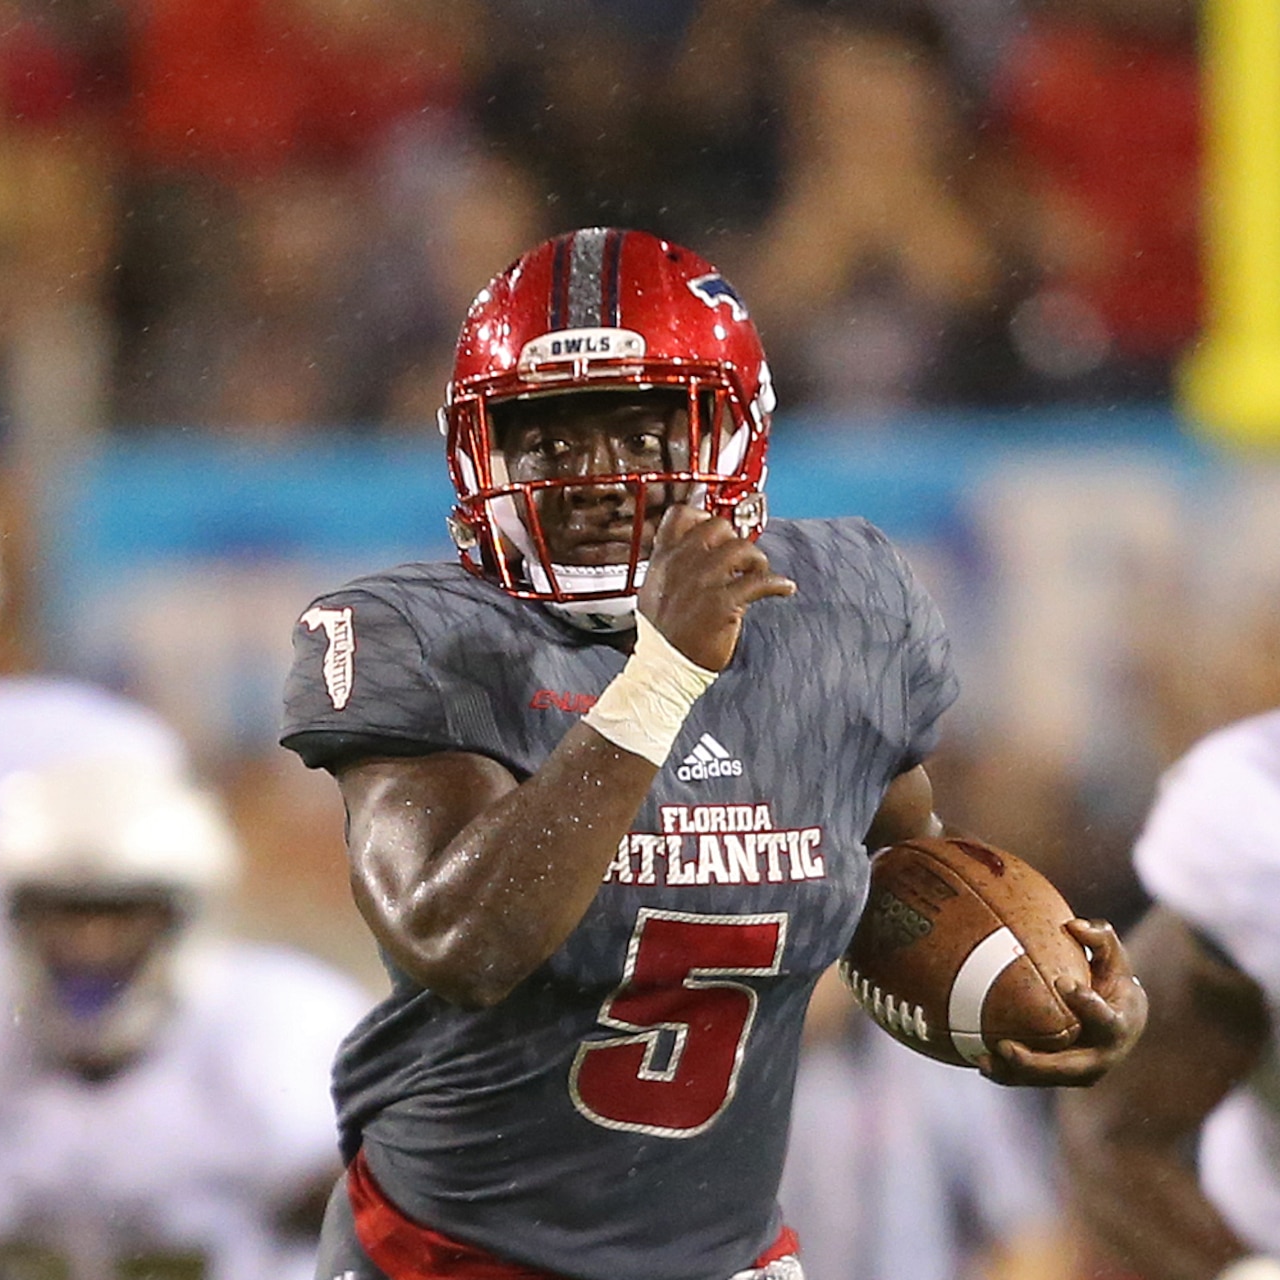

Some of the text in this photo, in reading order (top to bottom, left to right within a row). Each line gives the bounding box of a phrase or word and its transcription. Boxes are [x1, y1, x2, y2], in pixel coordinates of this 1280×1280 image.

[551, 336, 612, 356] OWLS
[332, 619, 350, 697] ATLANTIC
[676, 757, 744, 782] adidas
[659, 801, 773, 834] FLORIDA
[602, 827, 827, 887] ATLANTIC
[567, 906, 790, 1140] 5
